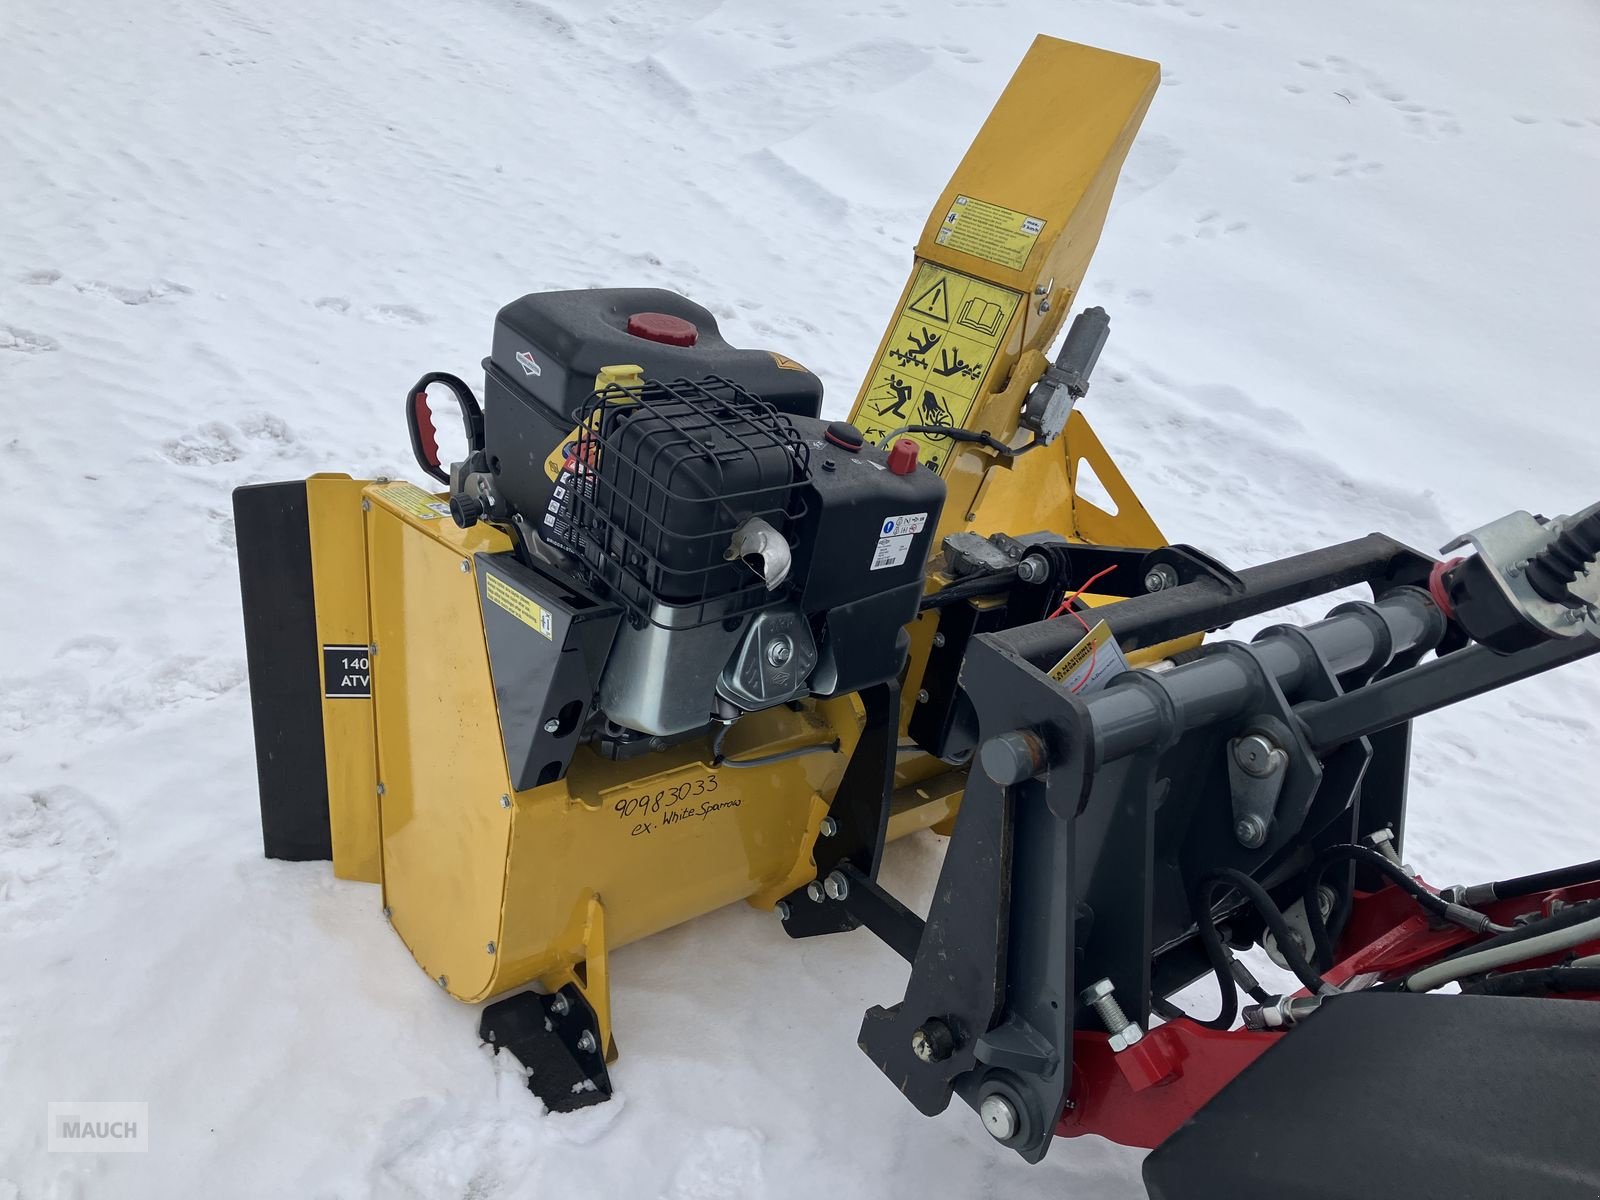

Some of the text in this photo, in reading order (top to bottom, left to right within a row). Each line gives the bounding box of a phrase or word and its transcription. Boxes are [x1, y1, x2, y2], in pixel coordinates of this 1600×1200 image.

[341, 657, 369, 670] 140
[340, 674, 370, 687] ATV
[614, 774, 718, 819] 90983033
